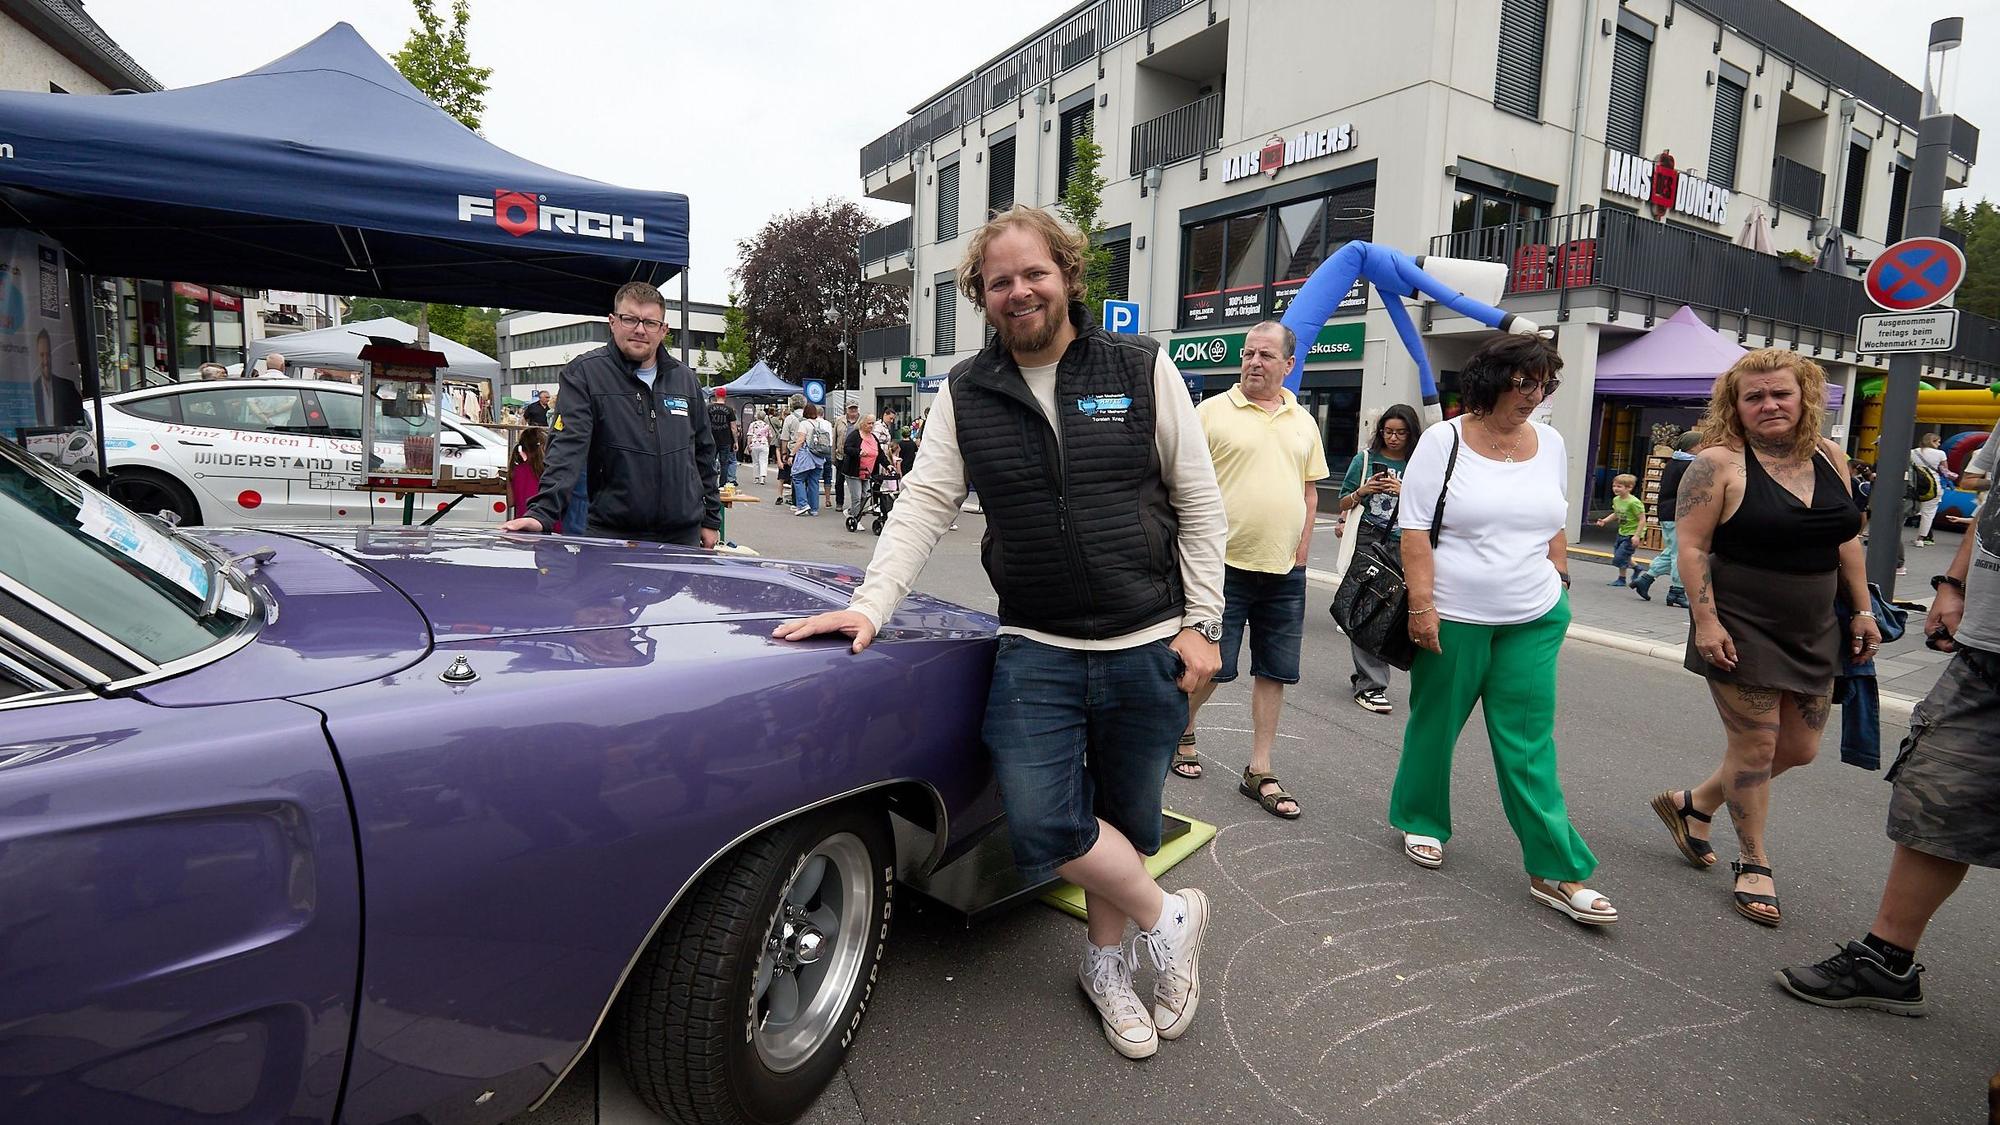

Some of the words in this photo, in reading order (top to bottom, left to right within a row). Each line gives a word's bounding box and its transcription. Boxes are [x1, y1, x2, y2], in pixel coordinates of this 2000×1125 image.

[1222, 151, 1260, 182] HAUS
[1607, 148, 1653, 201] HAUS
[1228, 296, 1243, 306] 100%
[1243, 294, 1258, 305] Halal
[1189, 307, 1214, 316] BERLINER
[1224, 306, 1239, 317] 100%
[1239, 304, 1261, 316] Original
[1113, 306, 1131, 333] P
[1878, 317, 1936, 327] Ausgenommen
[1878, 329, 1909, 338] freitags
[1912, 328, 1933, 336] beim
[1864, 339, 1917, 348] Wochenmarkt
[1173, 342, 1209, 362] AOK
[1307, 343, 1353, 355] skasse.
[905, 371, 920, 379] AOK
[166, 425, 221, 439] Prinz
[229, 430, 299, 447] Torsten
[329, 439, 392, 455] Sesson
[194, 452, 333, 471] WIDERSTAND
[841, 866, 893, 1049] BFGoodrich
